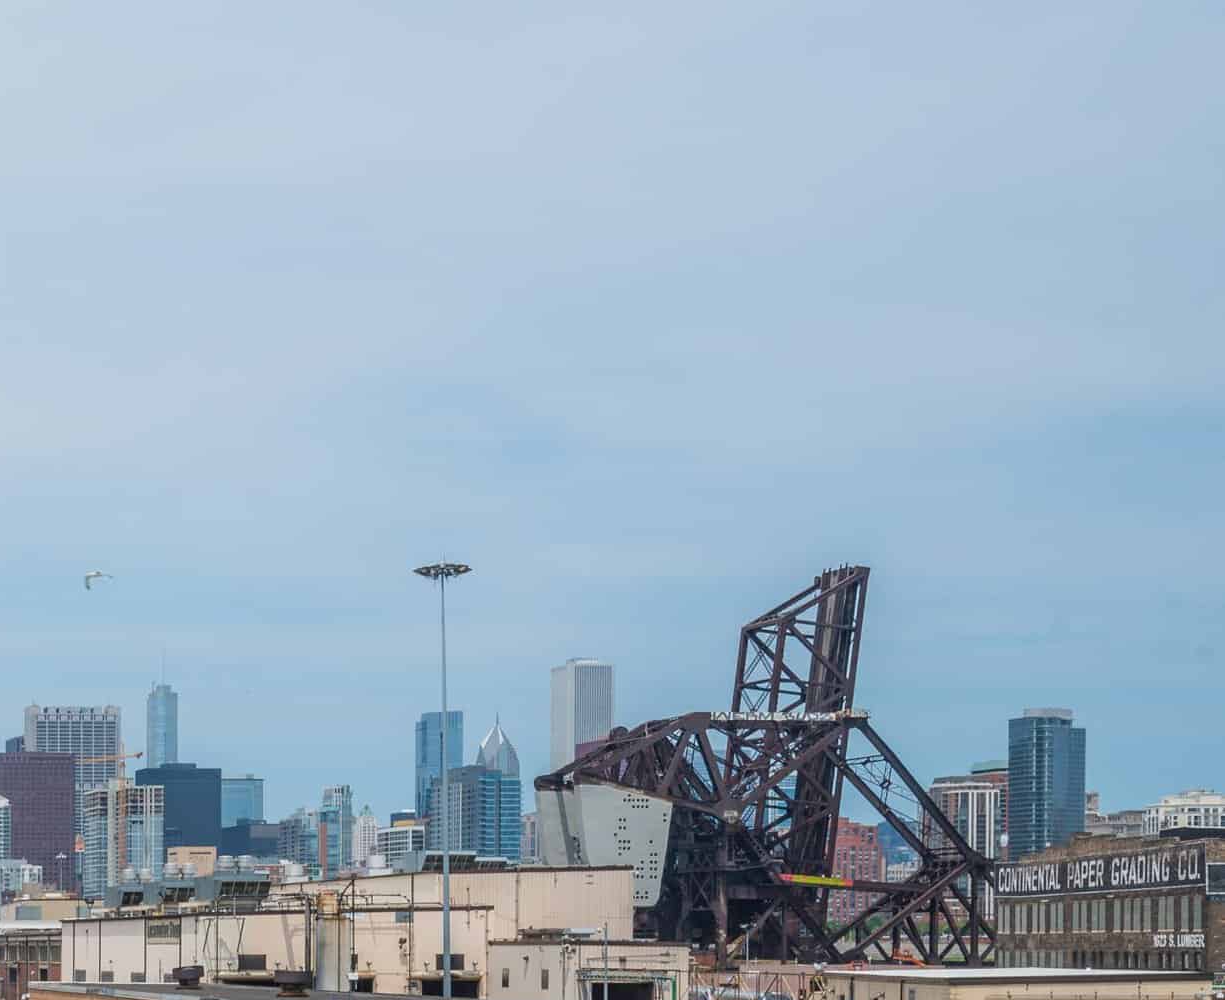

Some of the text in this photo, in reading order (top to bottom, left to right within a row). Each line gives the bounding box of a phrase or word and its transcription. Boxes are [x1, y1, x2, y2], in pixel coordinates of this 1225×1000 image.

[998, 848, 1200, 892] CONTINENTAL PAPER GRADING CO.
